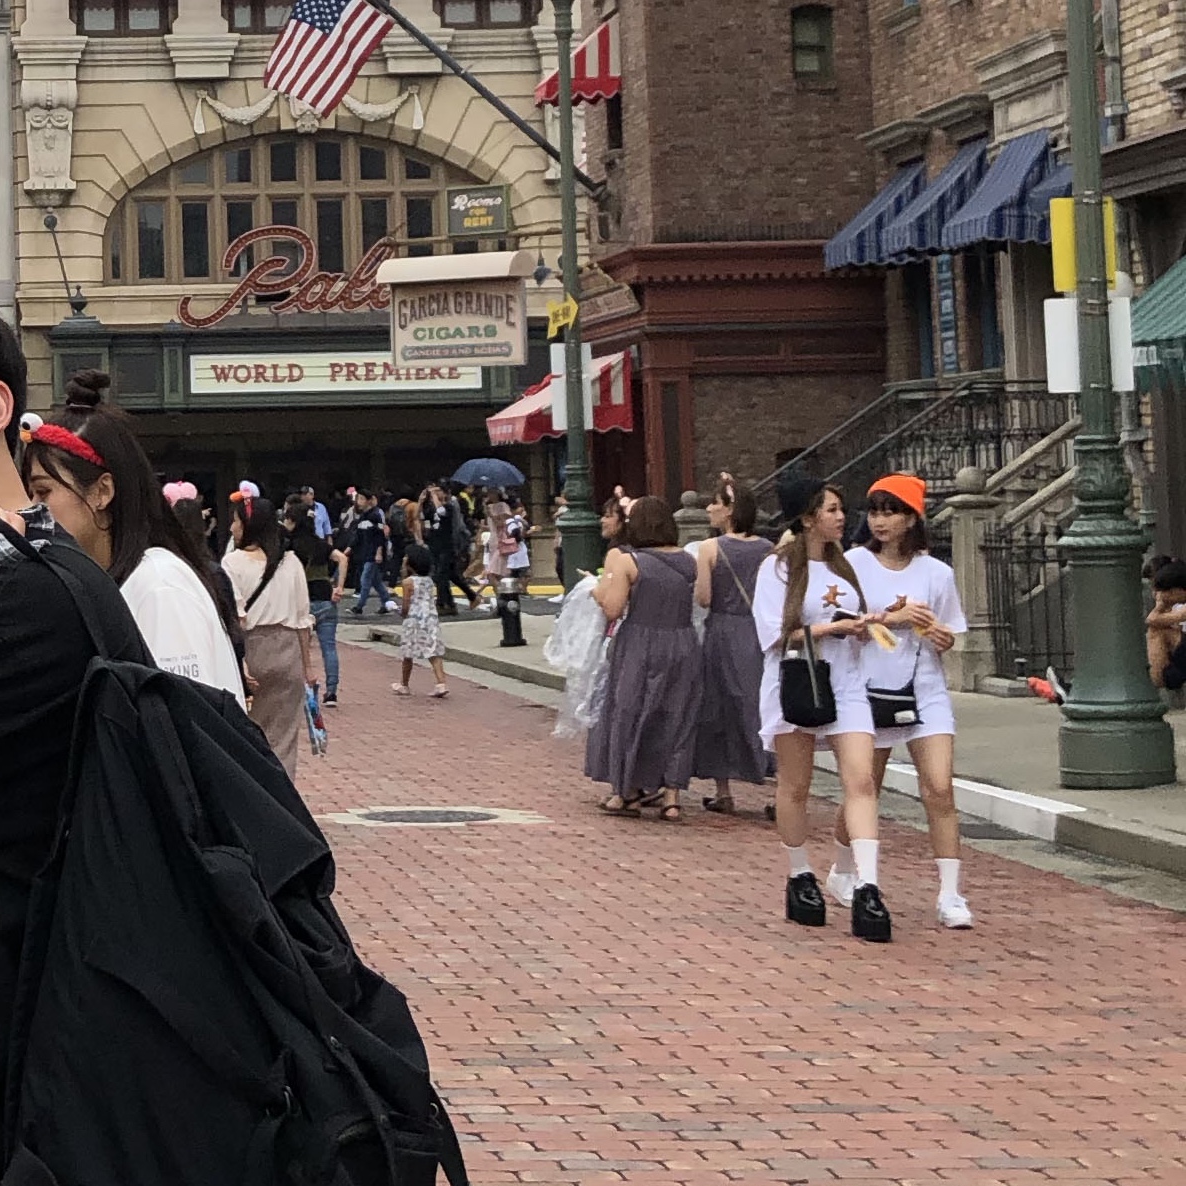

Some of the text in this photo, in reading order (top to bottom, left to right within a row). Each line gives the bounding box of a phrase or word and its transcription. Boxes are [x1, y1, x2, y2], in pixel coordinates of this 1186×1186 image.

[450, 194, 503, 211] Rooms
[462, 216, 494, 229] RENT
[397, 292, 451, 331] GARCIA
[453, 291, 517, 327] GRANDE
[413, 324, 498, 341] CIGARS
[451, 346, 471, 356] AND
[210, 361, 462, 384] WORLD PREMIERE
